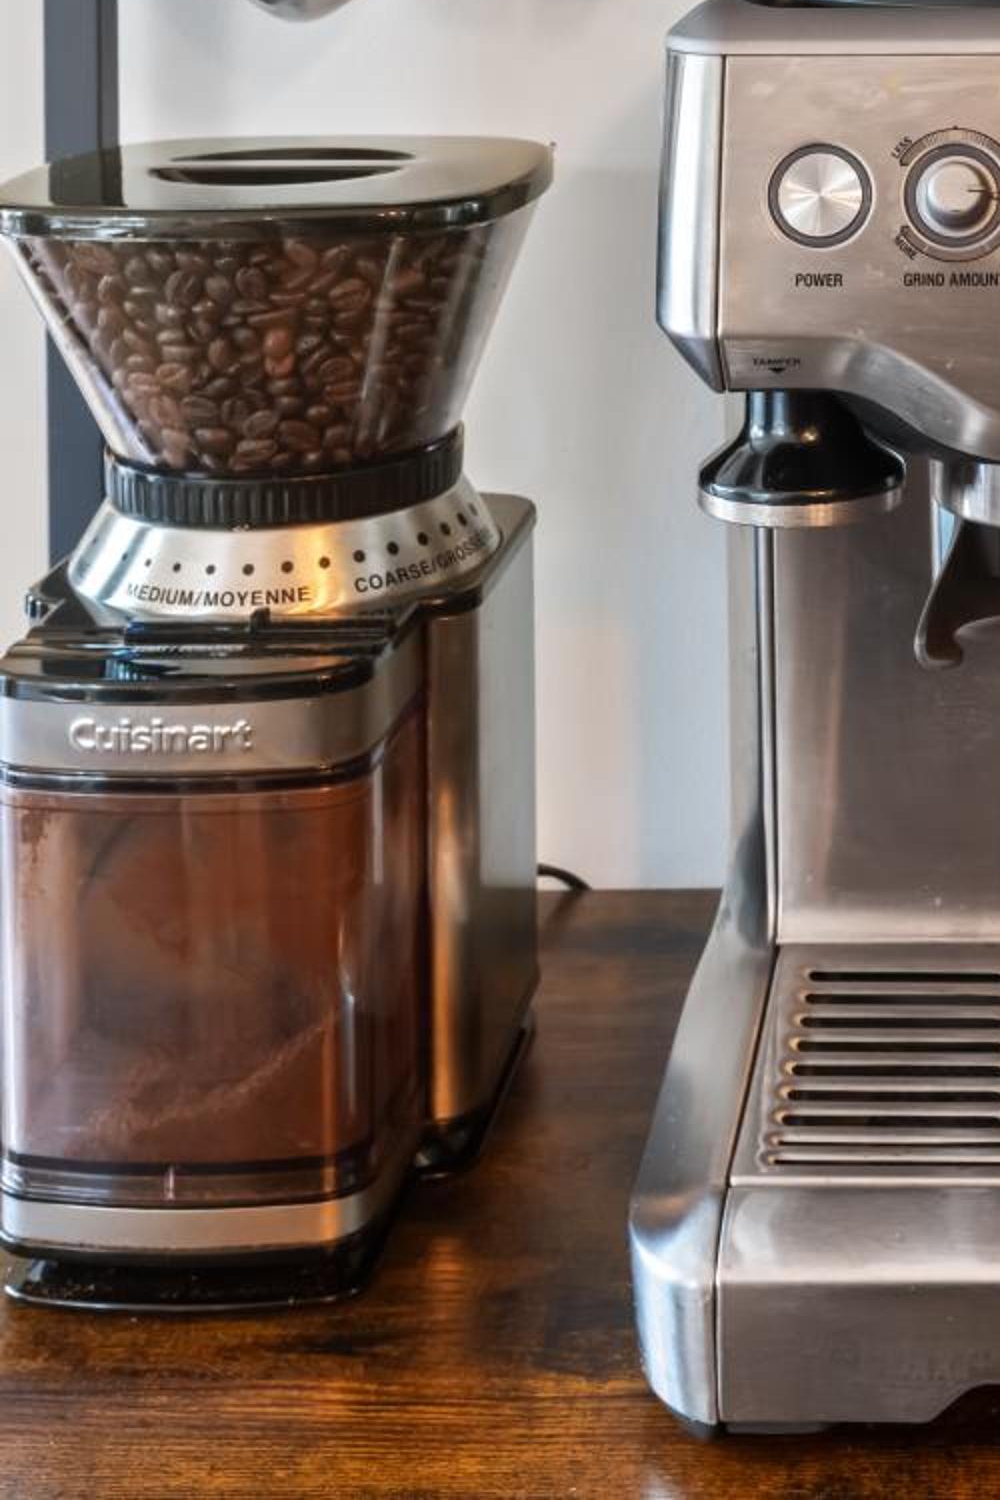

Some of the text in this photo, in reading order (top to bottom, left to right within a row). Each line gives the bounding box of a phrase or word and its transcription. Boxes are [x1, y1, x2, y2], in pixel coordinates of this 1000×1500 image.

[795, 273, 843, 287] POWER
[903, 273, 944, 287] GRIND
[126, 584, 311, 608] MEDIUM/MOYENNE
[70, 718, 253, 753] Cuisinart
